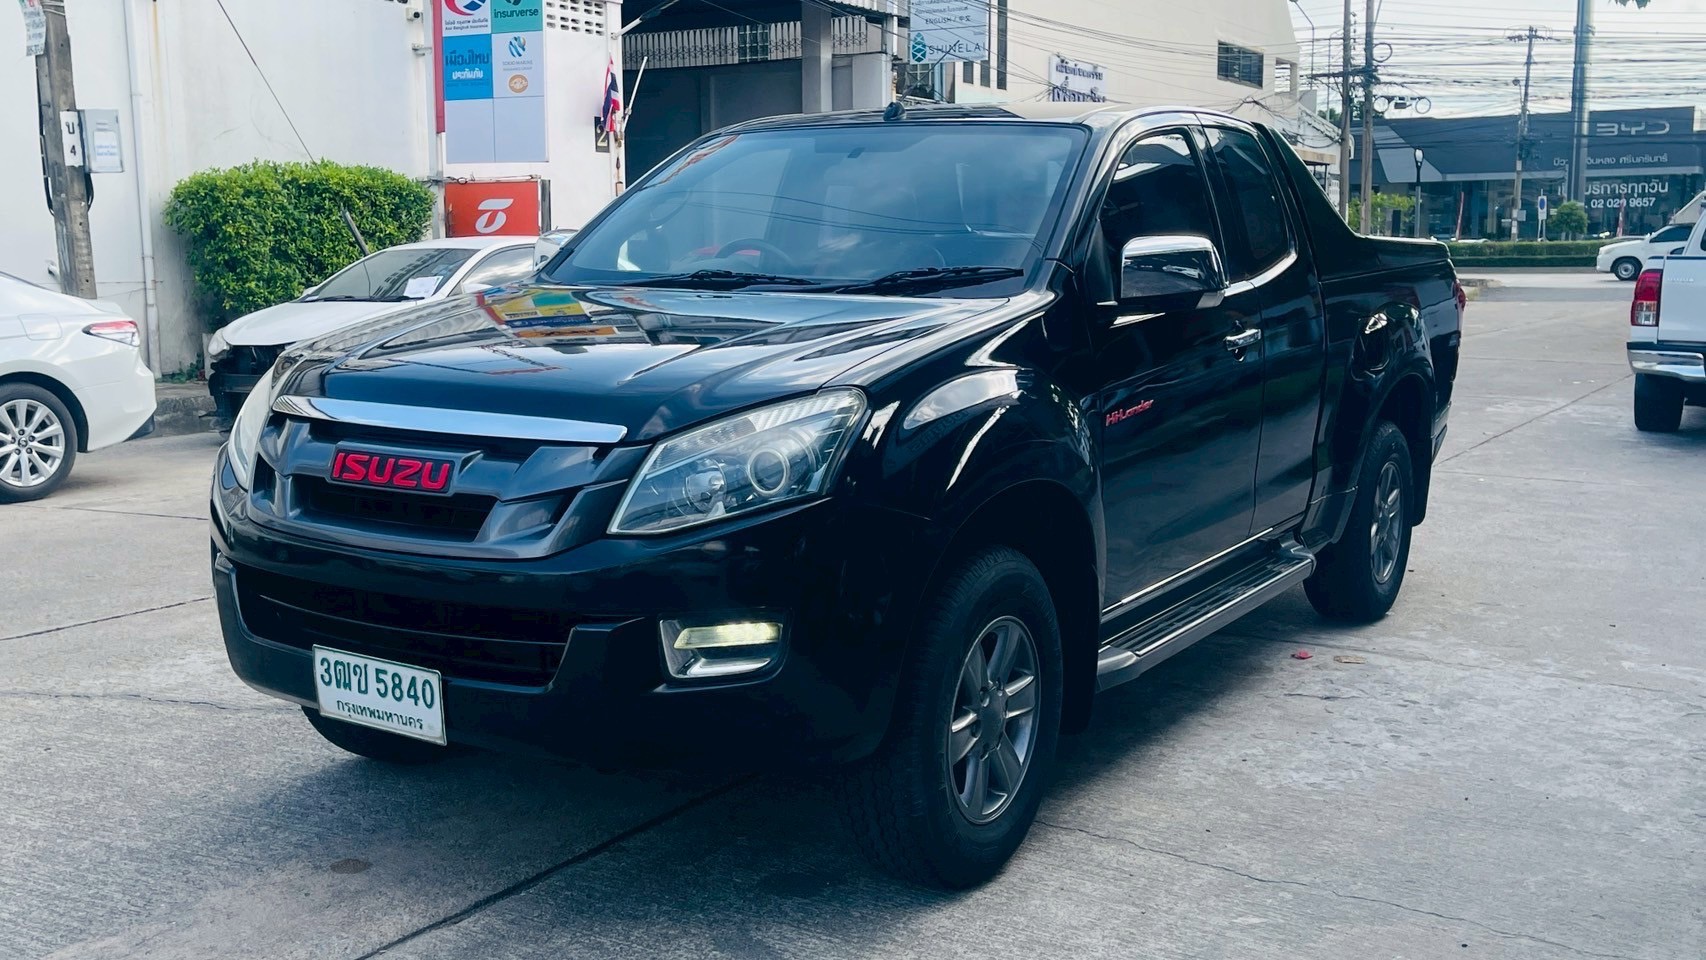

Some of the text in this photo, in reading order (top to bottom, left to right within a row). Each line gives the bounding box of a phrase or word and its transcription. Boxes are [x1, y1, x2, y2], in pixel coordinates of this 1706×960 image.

[494, 9, 538, 18] insurverse
[1596, 120, 1670, 136] BYD
[70, 144, 77, 156] 4
[1590, 199, 1604, 208] 02
[1629, 197, 1656, 207] 9657
[333, 452, 450, 490] ISUZU
[375, 667, 434, 709] 5840
[337, 700, 423, 730] กรุงเทพมหานคร
